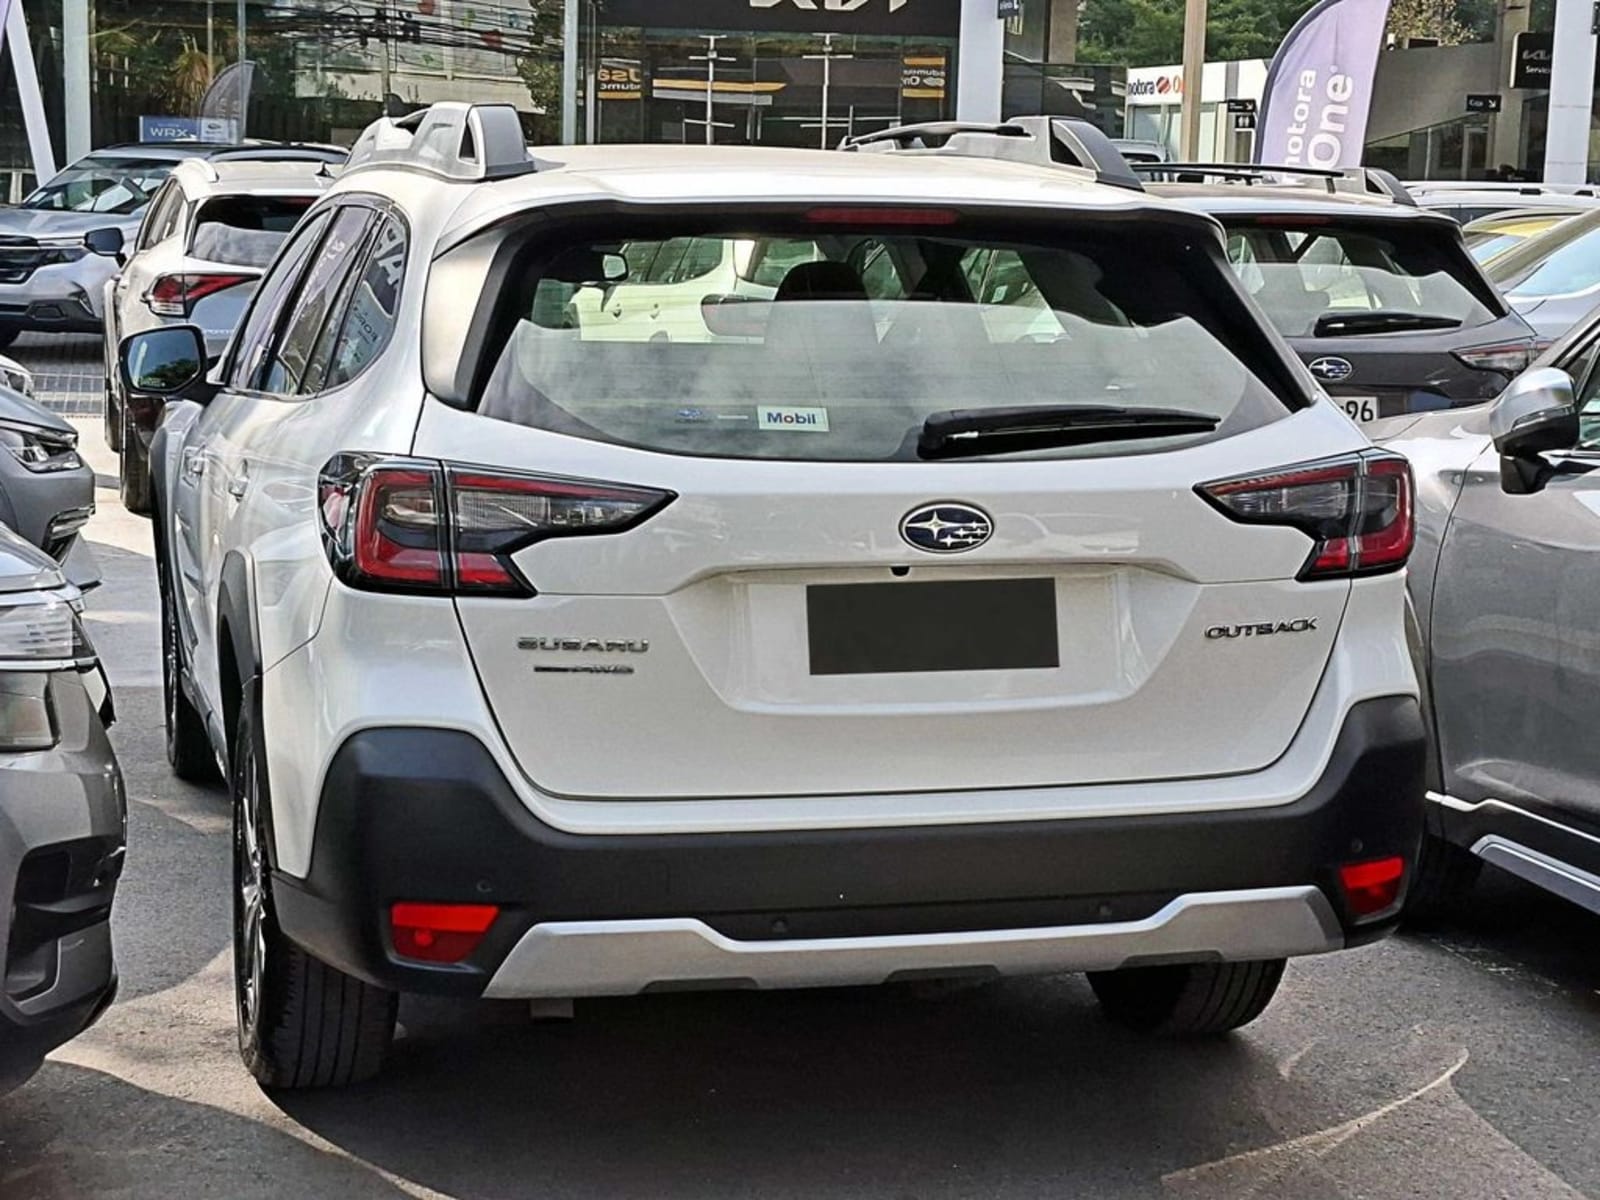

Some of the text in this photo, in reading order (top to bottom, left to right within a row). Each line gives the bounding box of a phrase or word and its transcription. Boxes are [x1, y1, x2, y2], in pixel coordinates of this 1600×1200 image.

[1307, 74, 1353, 169] One
[150, 128, 188, 138] WRX
[766, 411, 817, 425] Mobil
[1204, 617, 1318, 639] OUTBACK
[517, 638, 649, 653] SUBARU
